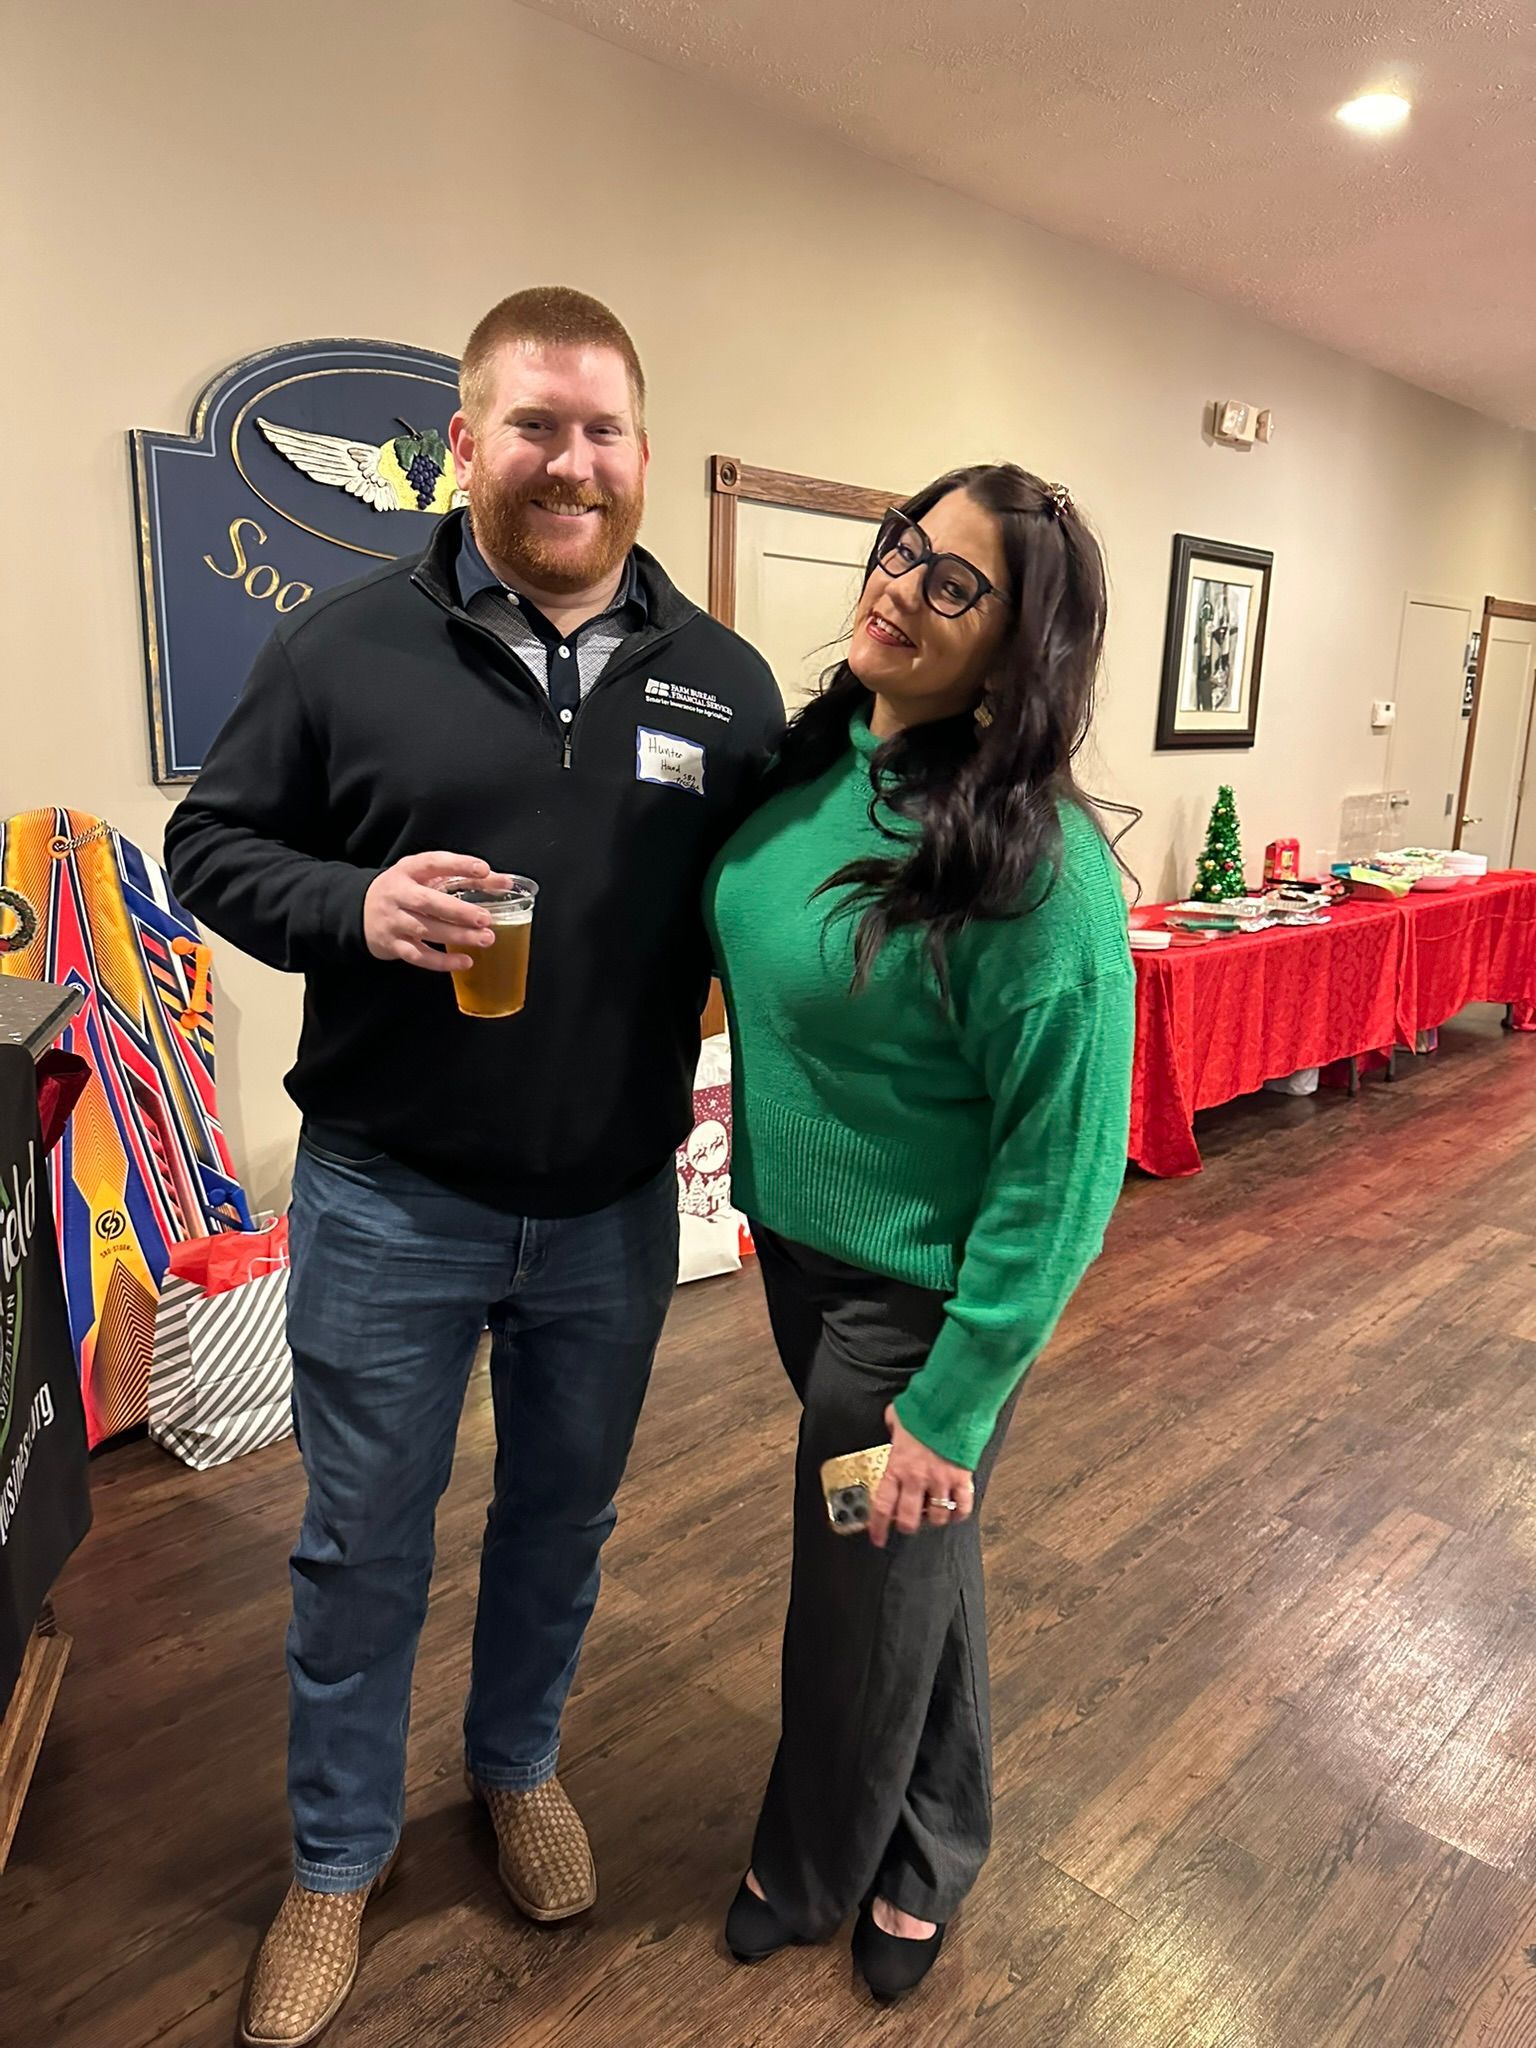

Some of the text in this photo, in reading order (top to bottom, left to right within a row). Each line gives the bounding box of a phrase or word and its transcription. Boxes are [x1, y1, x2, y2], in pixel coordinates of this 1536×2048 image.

[670, 684, 717, 702] FARM BUREAU
[671, 692, 733, 716] FINANCIAL SERVICES
[648, 736, 682, 758] Hunter
